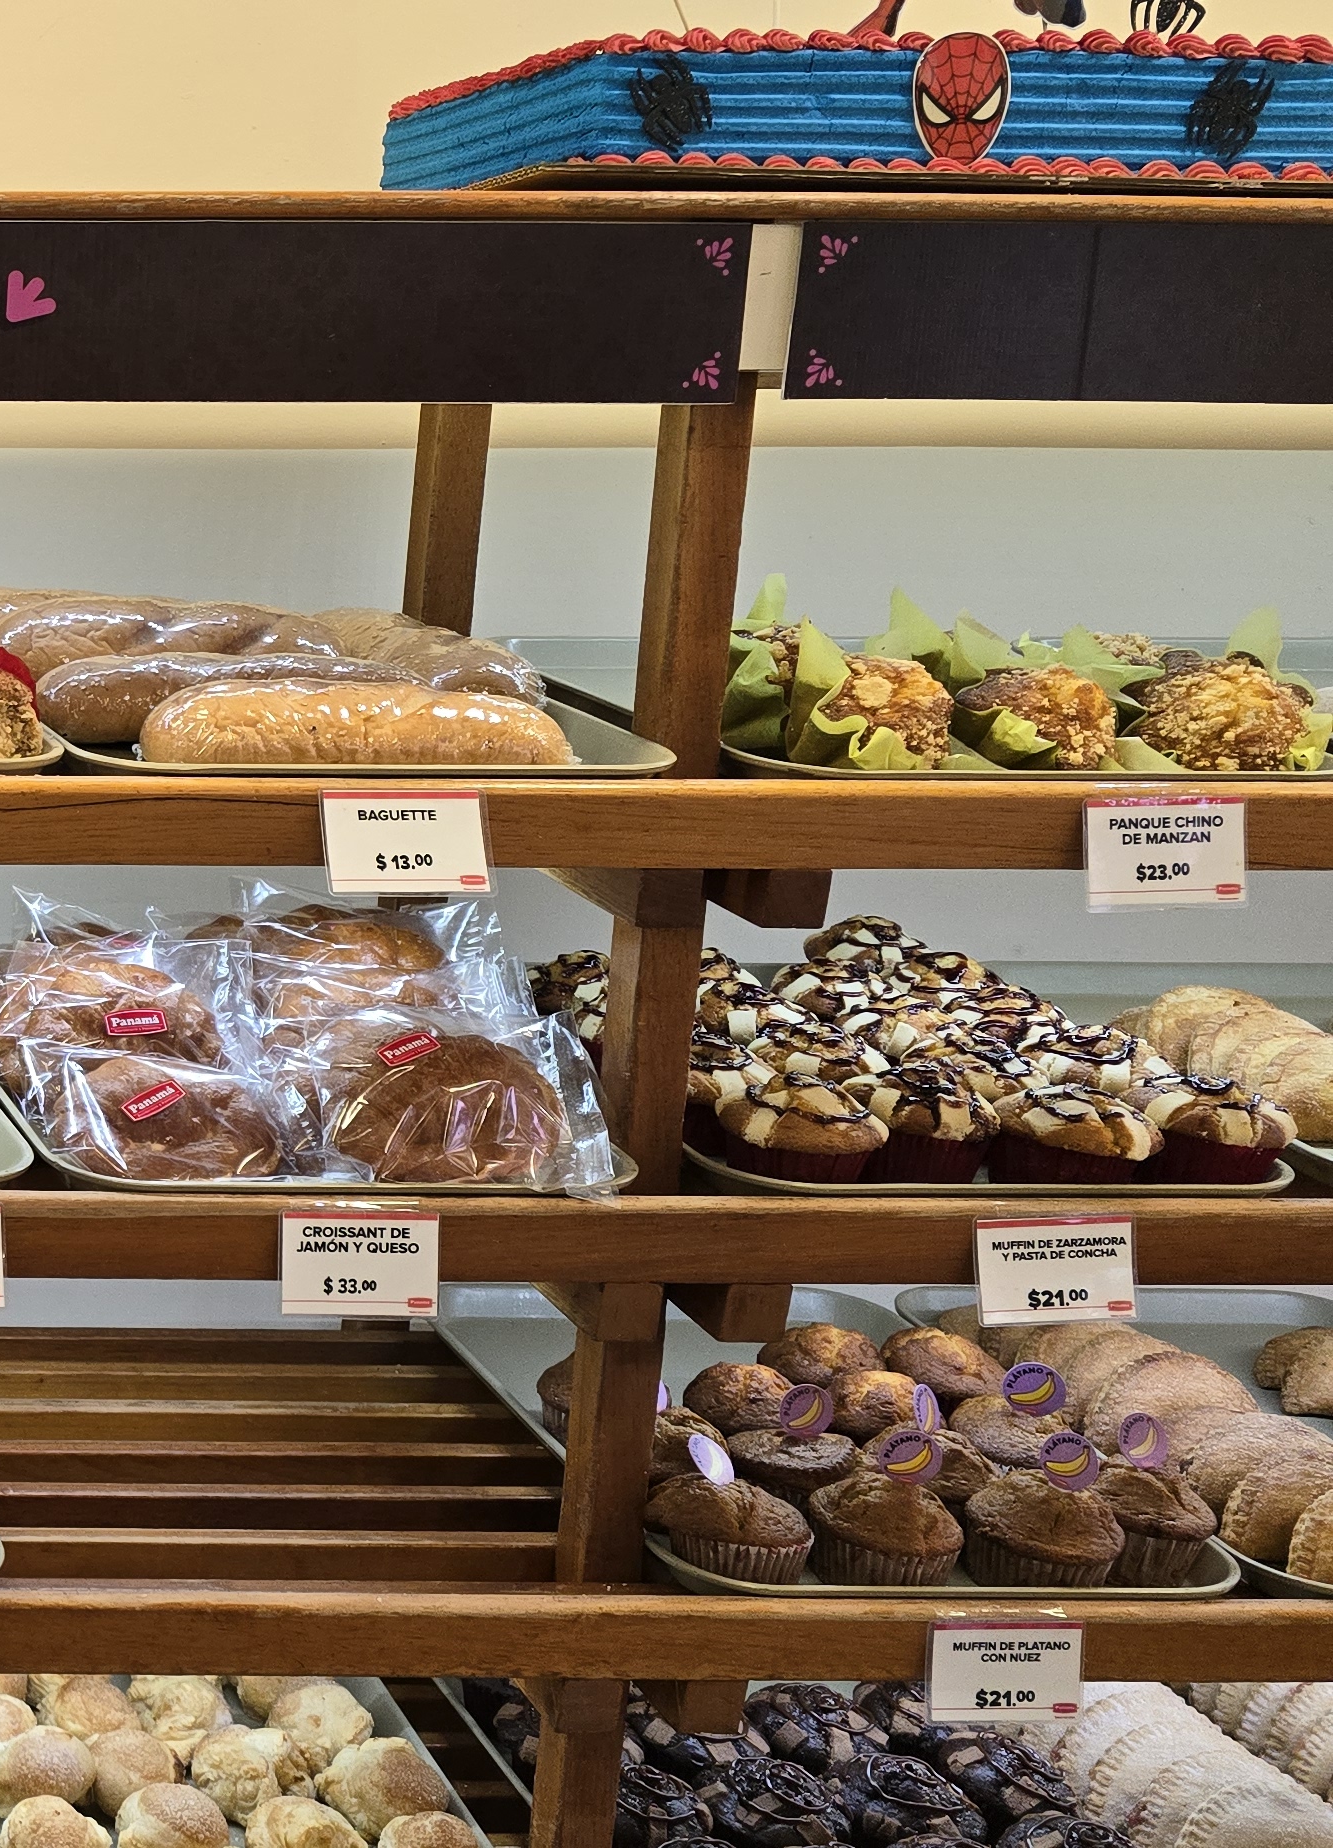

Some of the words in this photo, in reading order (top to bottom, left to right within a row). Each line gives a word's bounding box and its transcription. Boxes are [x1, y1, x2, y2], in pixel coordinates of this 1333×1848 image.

[357, 809, 437, 821] BAGUETTE
[1109, 816, 1171, 830] PANQUE
[1174, 815, 1224, 828] CHINO
[1122, 833, 1142, 845] DE
[1145, 831, 1211, 844] MANZAN
[375, 853, 387, 871] $
[391, 853, 433, 870] 13.00
[1136, 862, 1190, 883] $23.00
[110, 1014, 160, 1027] Panamá
[383, 1035, 431, 1059] Panamá
[127, 1085, 175, 1113] Panamá
[302, 1226, 386, 1239] CROISSANT
[390, 1227, 411, 1239] DE
[296, 1238, 349, 1253] JAMÓN
[352, 1241, 364, 1253] Y
[366, 1242, 420, 1254] QUESO
[991, 1240, 1035, 1251] MUFFIN
[1038, 1239, 1053, 1249] DE
[1055, 1236, 1127, 1248] ZARZAMORA
[1001, 1252, 1010, 1261] Y
[1012, 1251, 1048, 1261] PASTA
[1050, 1250, 1065, 1260] DE
[1067, 1248, 1117, 1259] CONCHA
[323, 1276, 334, 1295] $
[337, 1278, 377, 1294] 33.00
[1028, 1288, 1089, 1310] $21.00
[1007, 1366, 1044, 1389] PLÁTANO
[883, 1435, 921, 1459] PLÁTANO
[1045, 1436, 1082, 1456] PLÁTANO
[952, 1641, 997, 1651] MUFFIN
[999, 1641, 1015, 1651] DE
[1017, 1641, 1071, 1651] PLATANO
[980, 1652, 1007, 1662] CON
[1009, 1652, 1041, 1662] NUEZ
[975, 1688, 1035, 1709] $21.00
